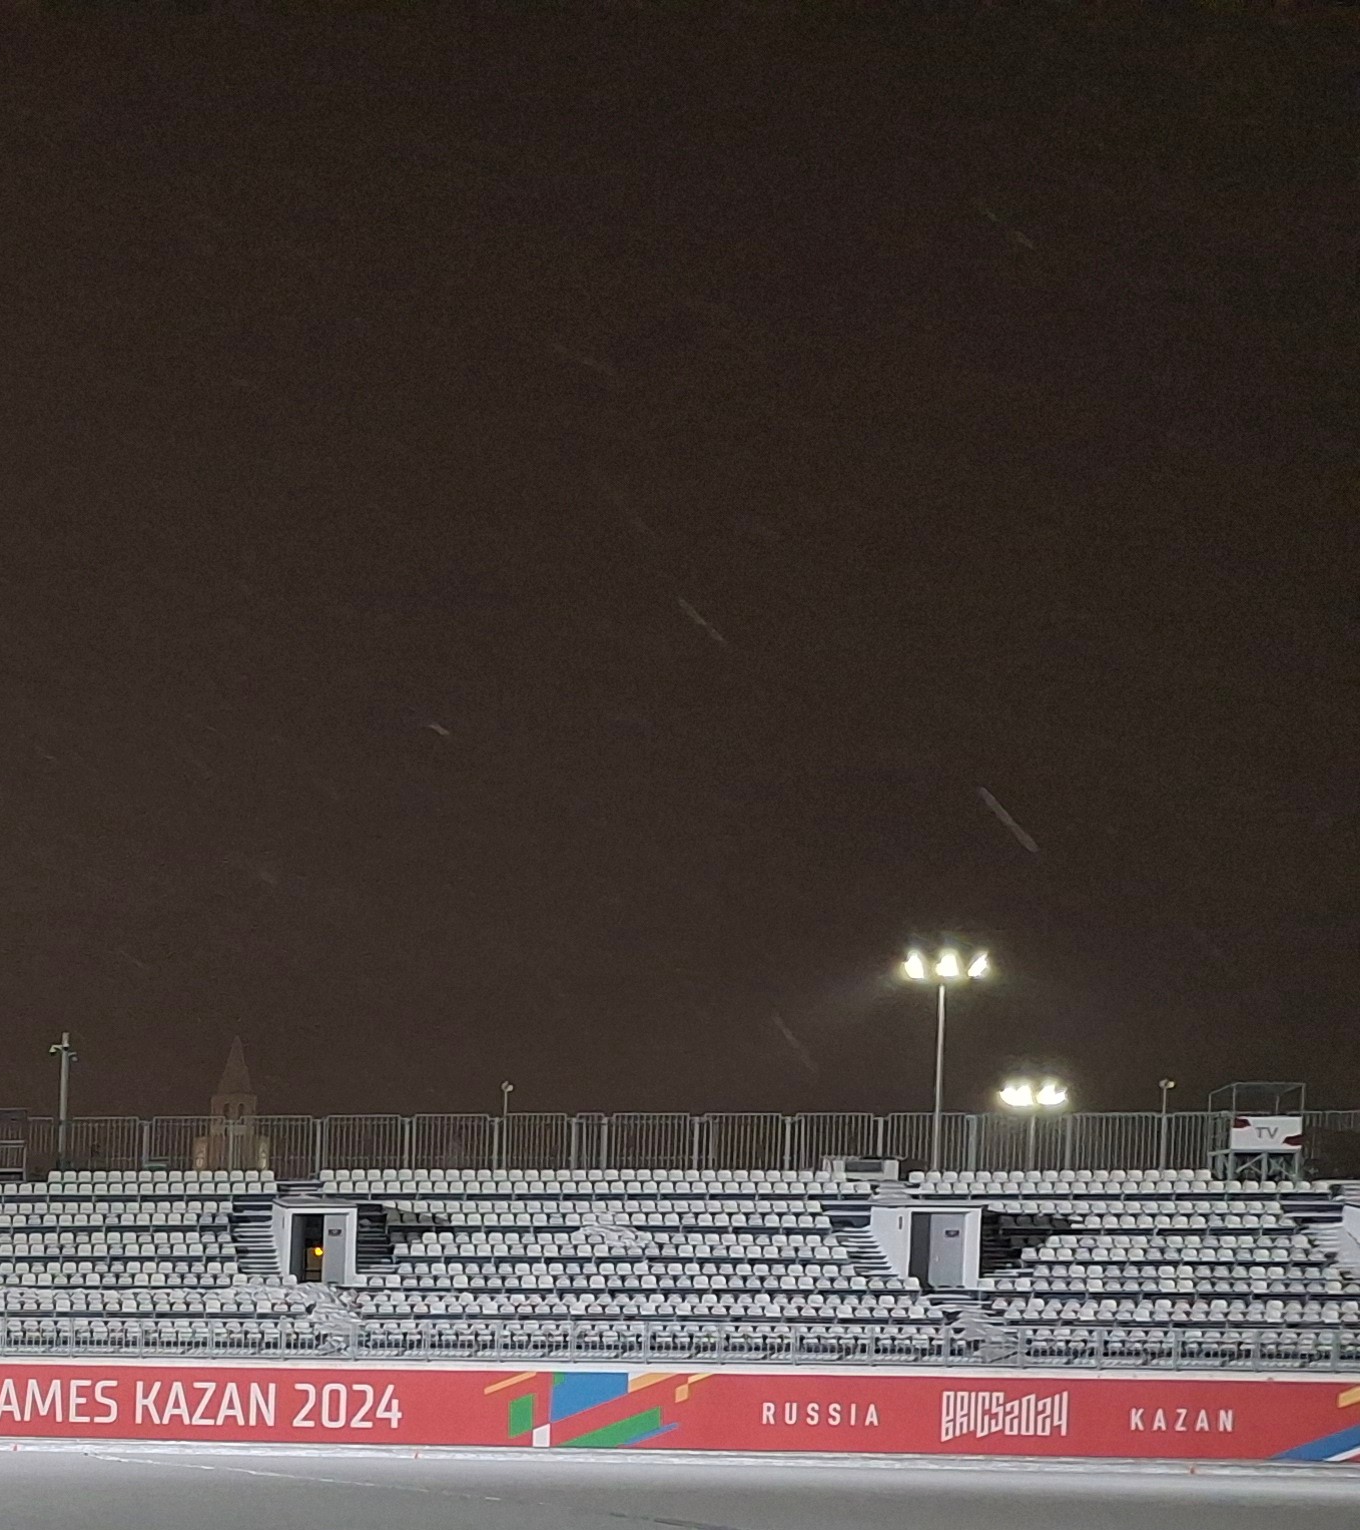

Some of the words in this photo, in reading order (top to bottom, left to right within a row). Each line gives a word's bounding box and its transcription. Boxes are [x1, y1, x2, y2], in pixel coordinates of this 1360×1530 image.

[1255, 1127, 1278, 1139] TV
[135, 1381, 276, 1427] KAZAN
[292, 1383, 402, 1429] 2024
[762, 1402, 879, 1426] RUSSIA
[1130, 1408, 1233, 1432] KAZAN
